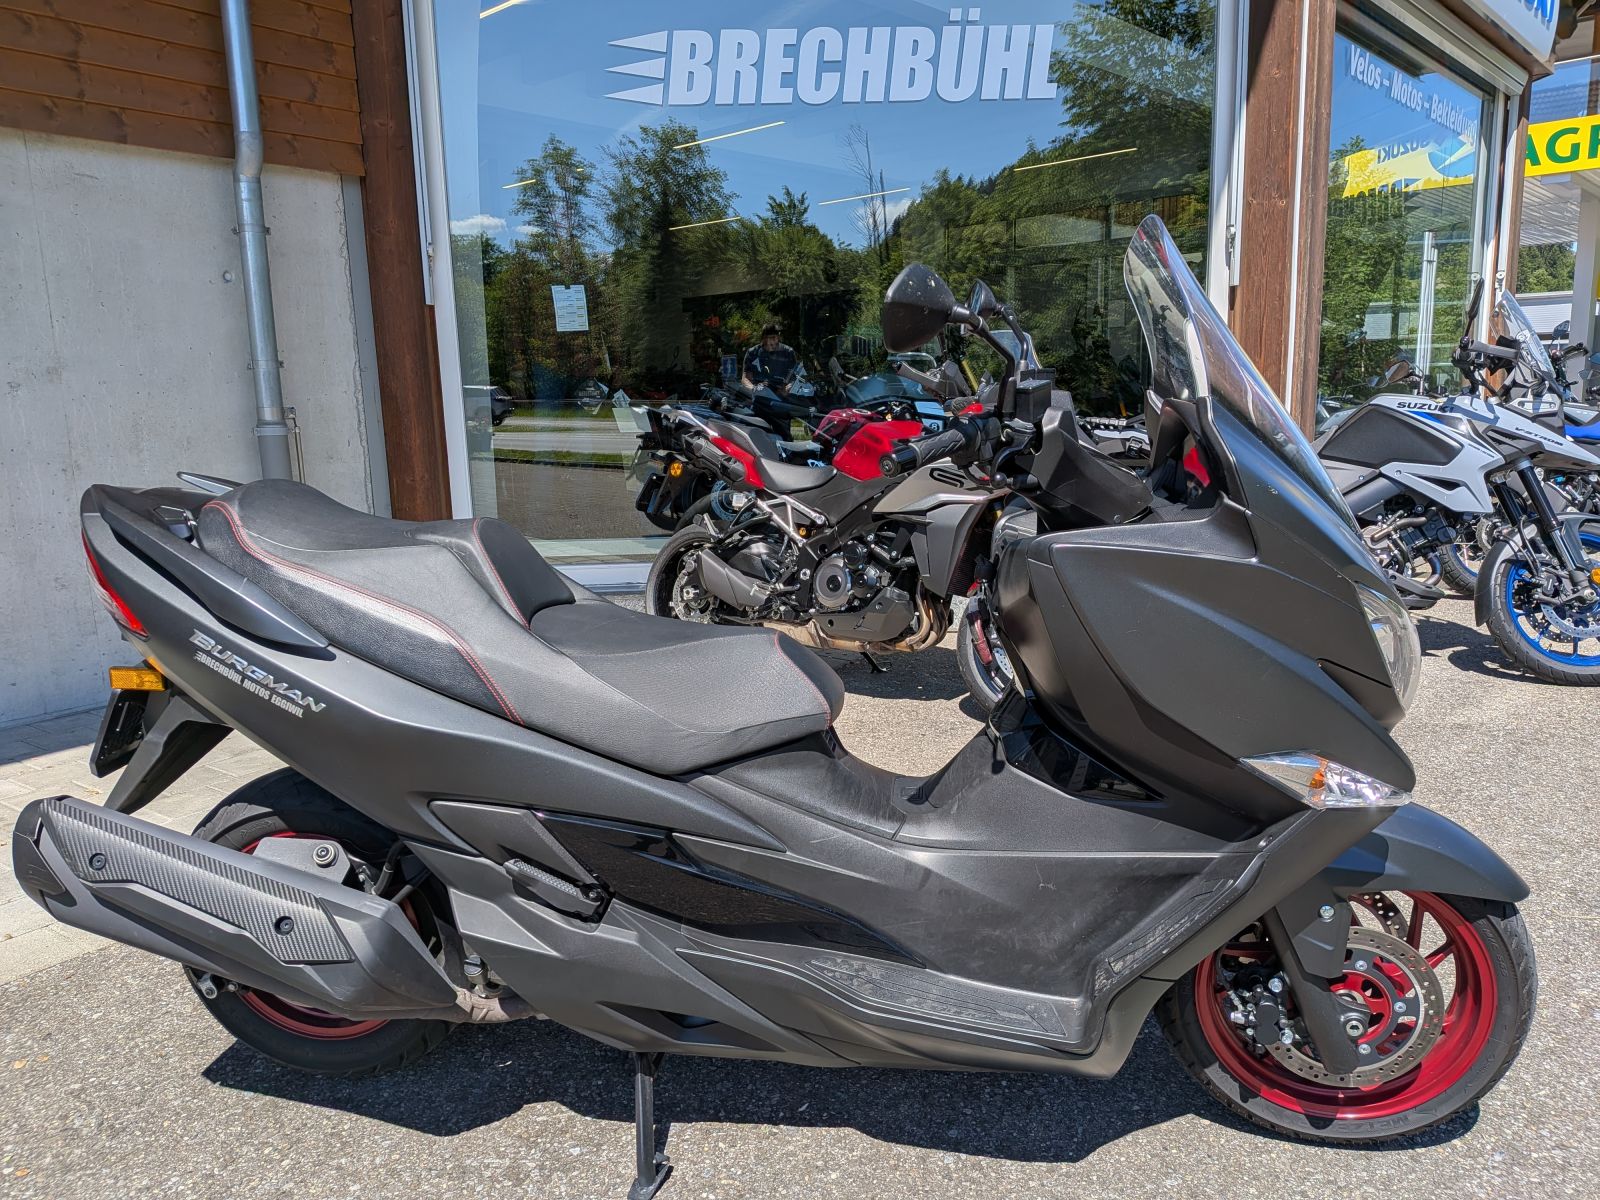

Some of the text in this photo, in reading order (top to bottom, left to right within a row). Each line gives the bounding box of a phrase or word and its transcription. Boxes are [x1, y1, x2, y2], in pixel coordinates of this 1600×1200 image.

[667, 7, 1059, 105] BRECHBÜHL
[1350, 44, 1382, 90] Velos
[1390, 70, 1423, 112] Motos
[1430, 92, 1478, 148] Bekleidung
[1396, 401, 1454, 413] SUZUKI
[189, 628, 327, 713] BURGMAN
[199, 652, 304, 718] BRECHBÜHL MOTOS EGGIWIL
